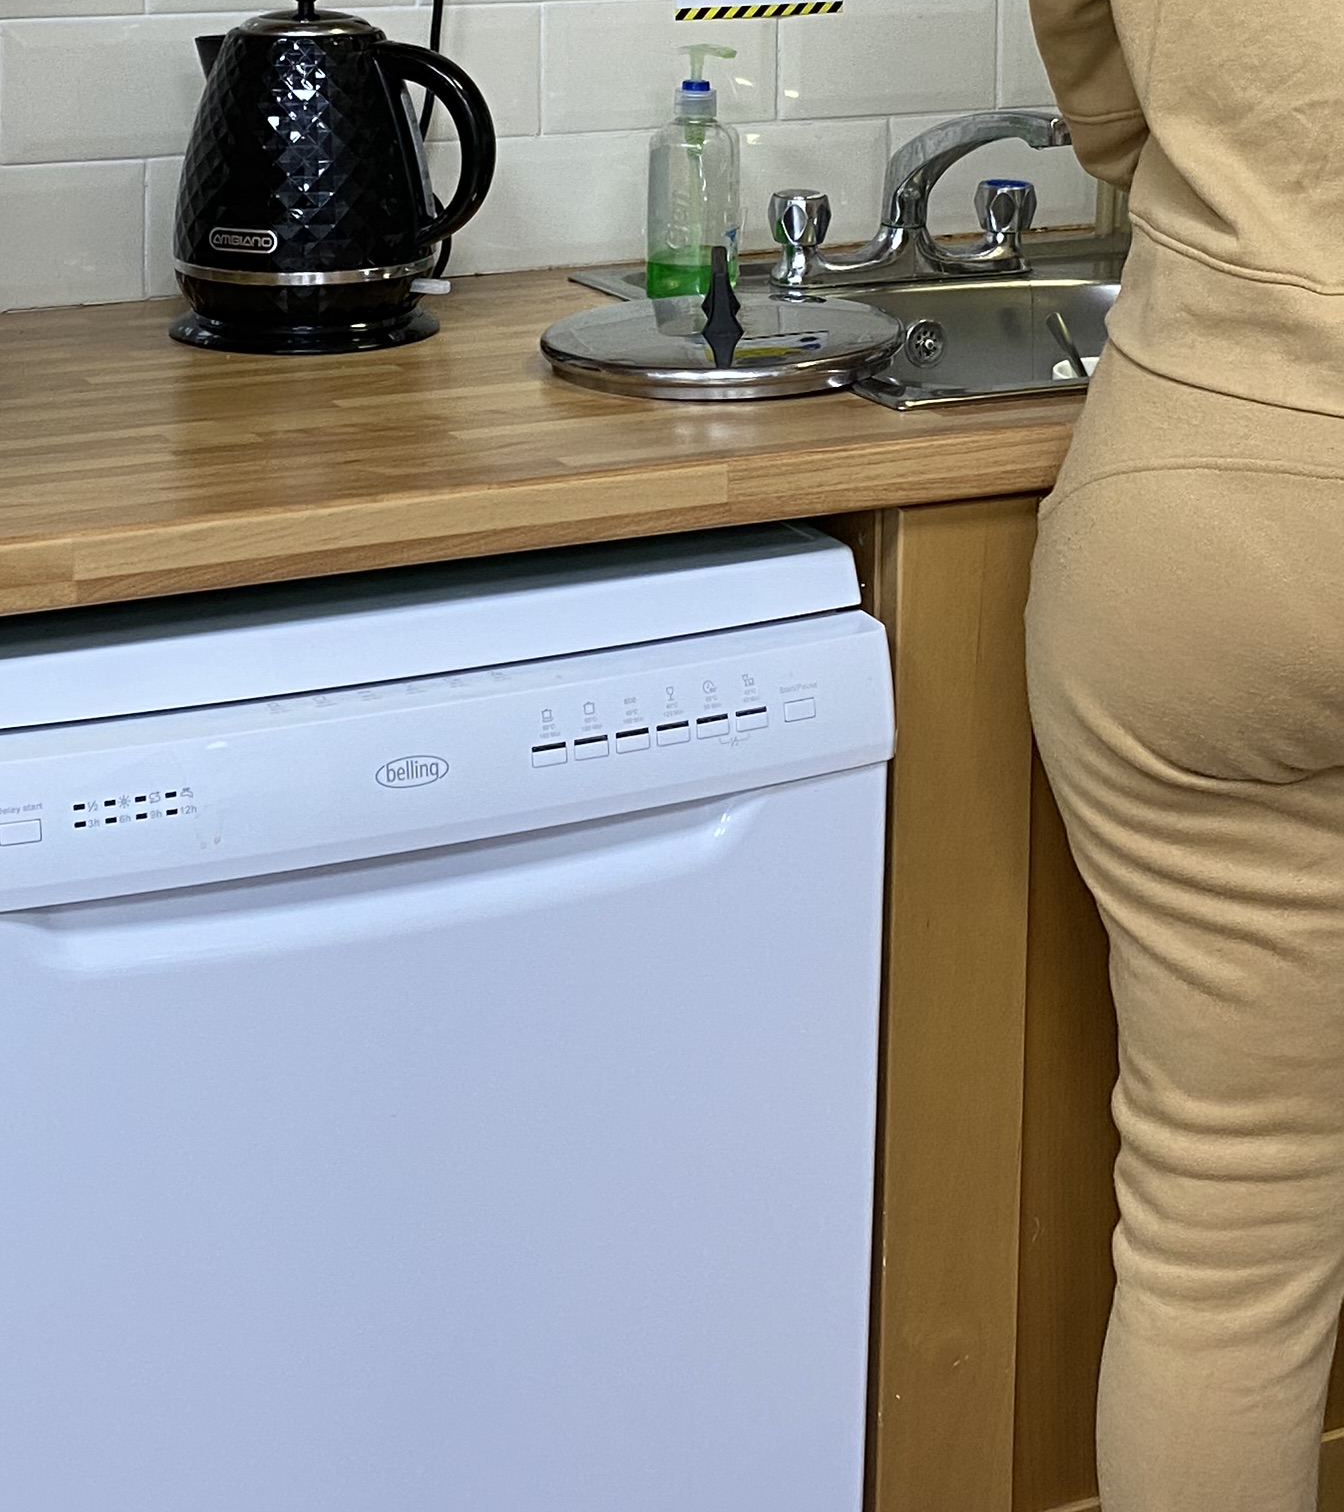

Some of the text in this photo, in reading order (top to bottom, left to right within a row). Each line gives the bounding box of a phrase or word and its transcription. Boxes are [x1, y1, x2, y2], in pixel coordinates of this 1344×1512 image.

[212, 233, 273, 248] AMBIANO
[386, 759, 440, 783] belling
[22, 802, 43, 813] start
